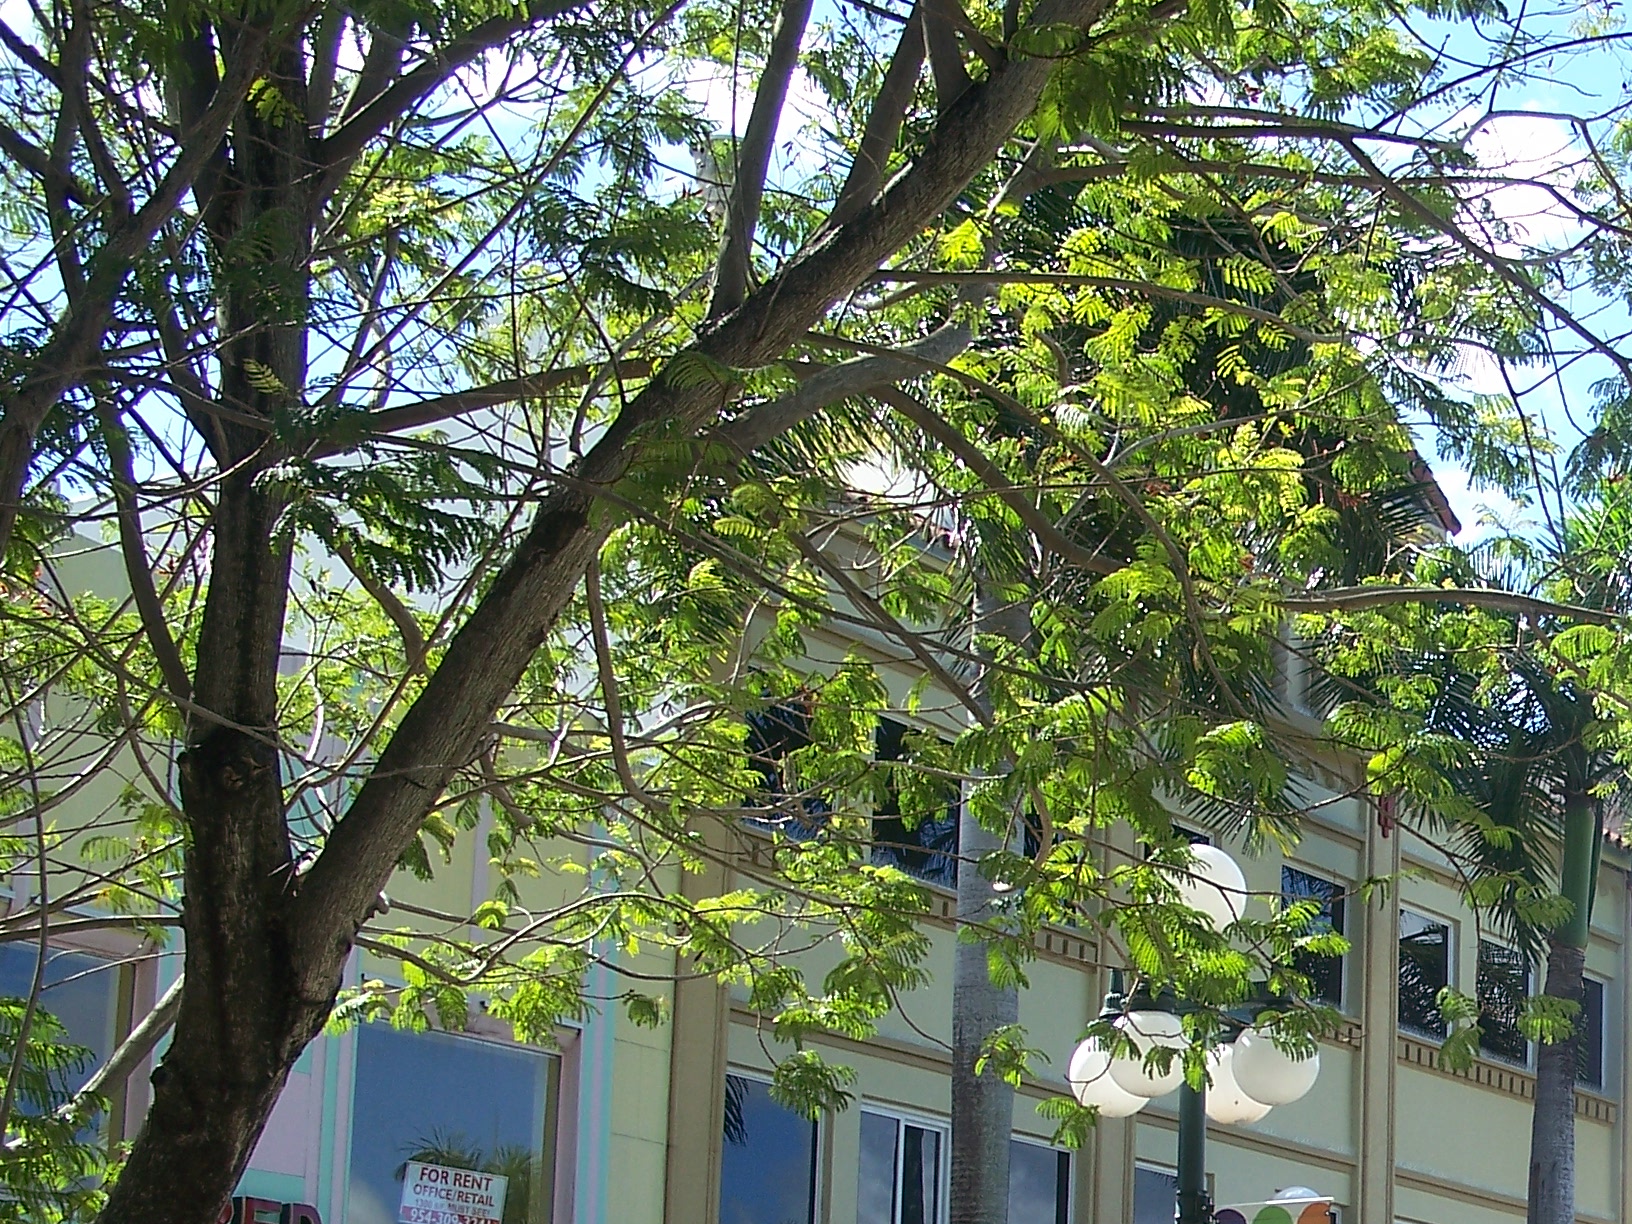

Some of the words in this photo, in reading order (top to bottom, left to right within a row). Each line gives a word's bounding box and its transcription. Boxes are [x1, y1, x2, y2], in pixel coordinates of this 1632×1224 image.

[420, 1167, 449, 1185] FOR
[453, 1172, 493, 1192] RENT
[413, 1183, 495, 1207] OFFICE/RETAIL
